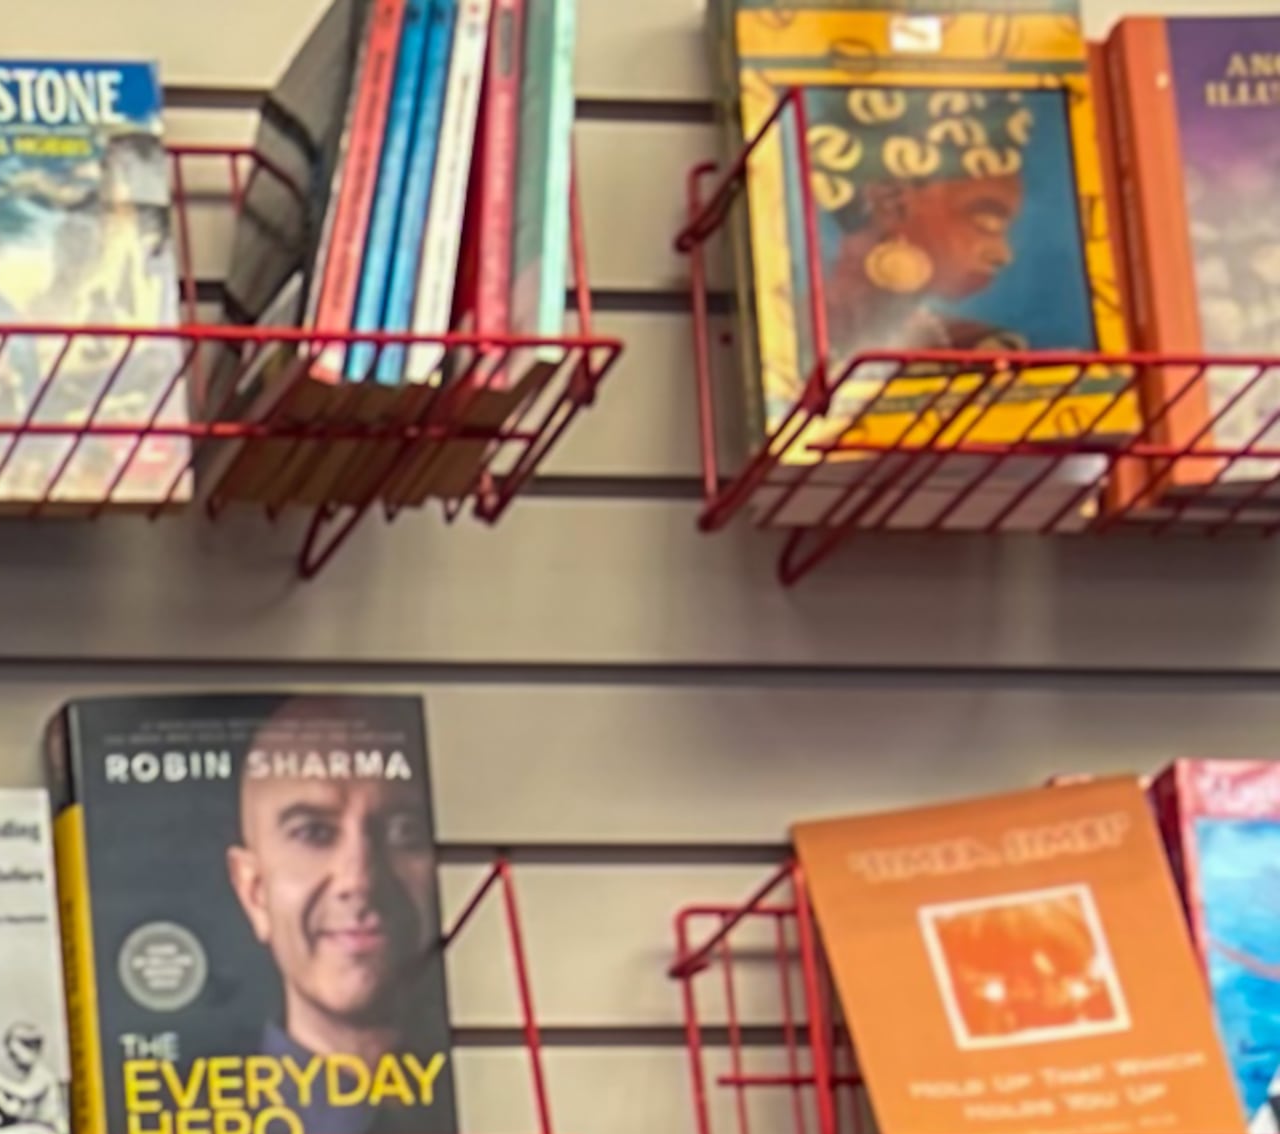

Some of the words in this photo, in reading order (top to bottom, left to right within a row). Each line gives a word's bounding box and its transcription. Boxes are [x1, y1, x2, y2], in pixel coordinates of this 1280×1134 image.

[104, 750, 233, 784] ROBIN
[246, 749, 413, 781] SHARMA
[120, 1032, 180, 1061] THE
[123, 1052, 446, 1114] EVERYDAY
